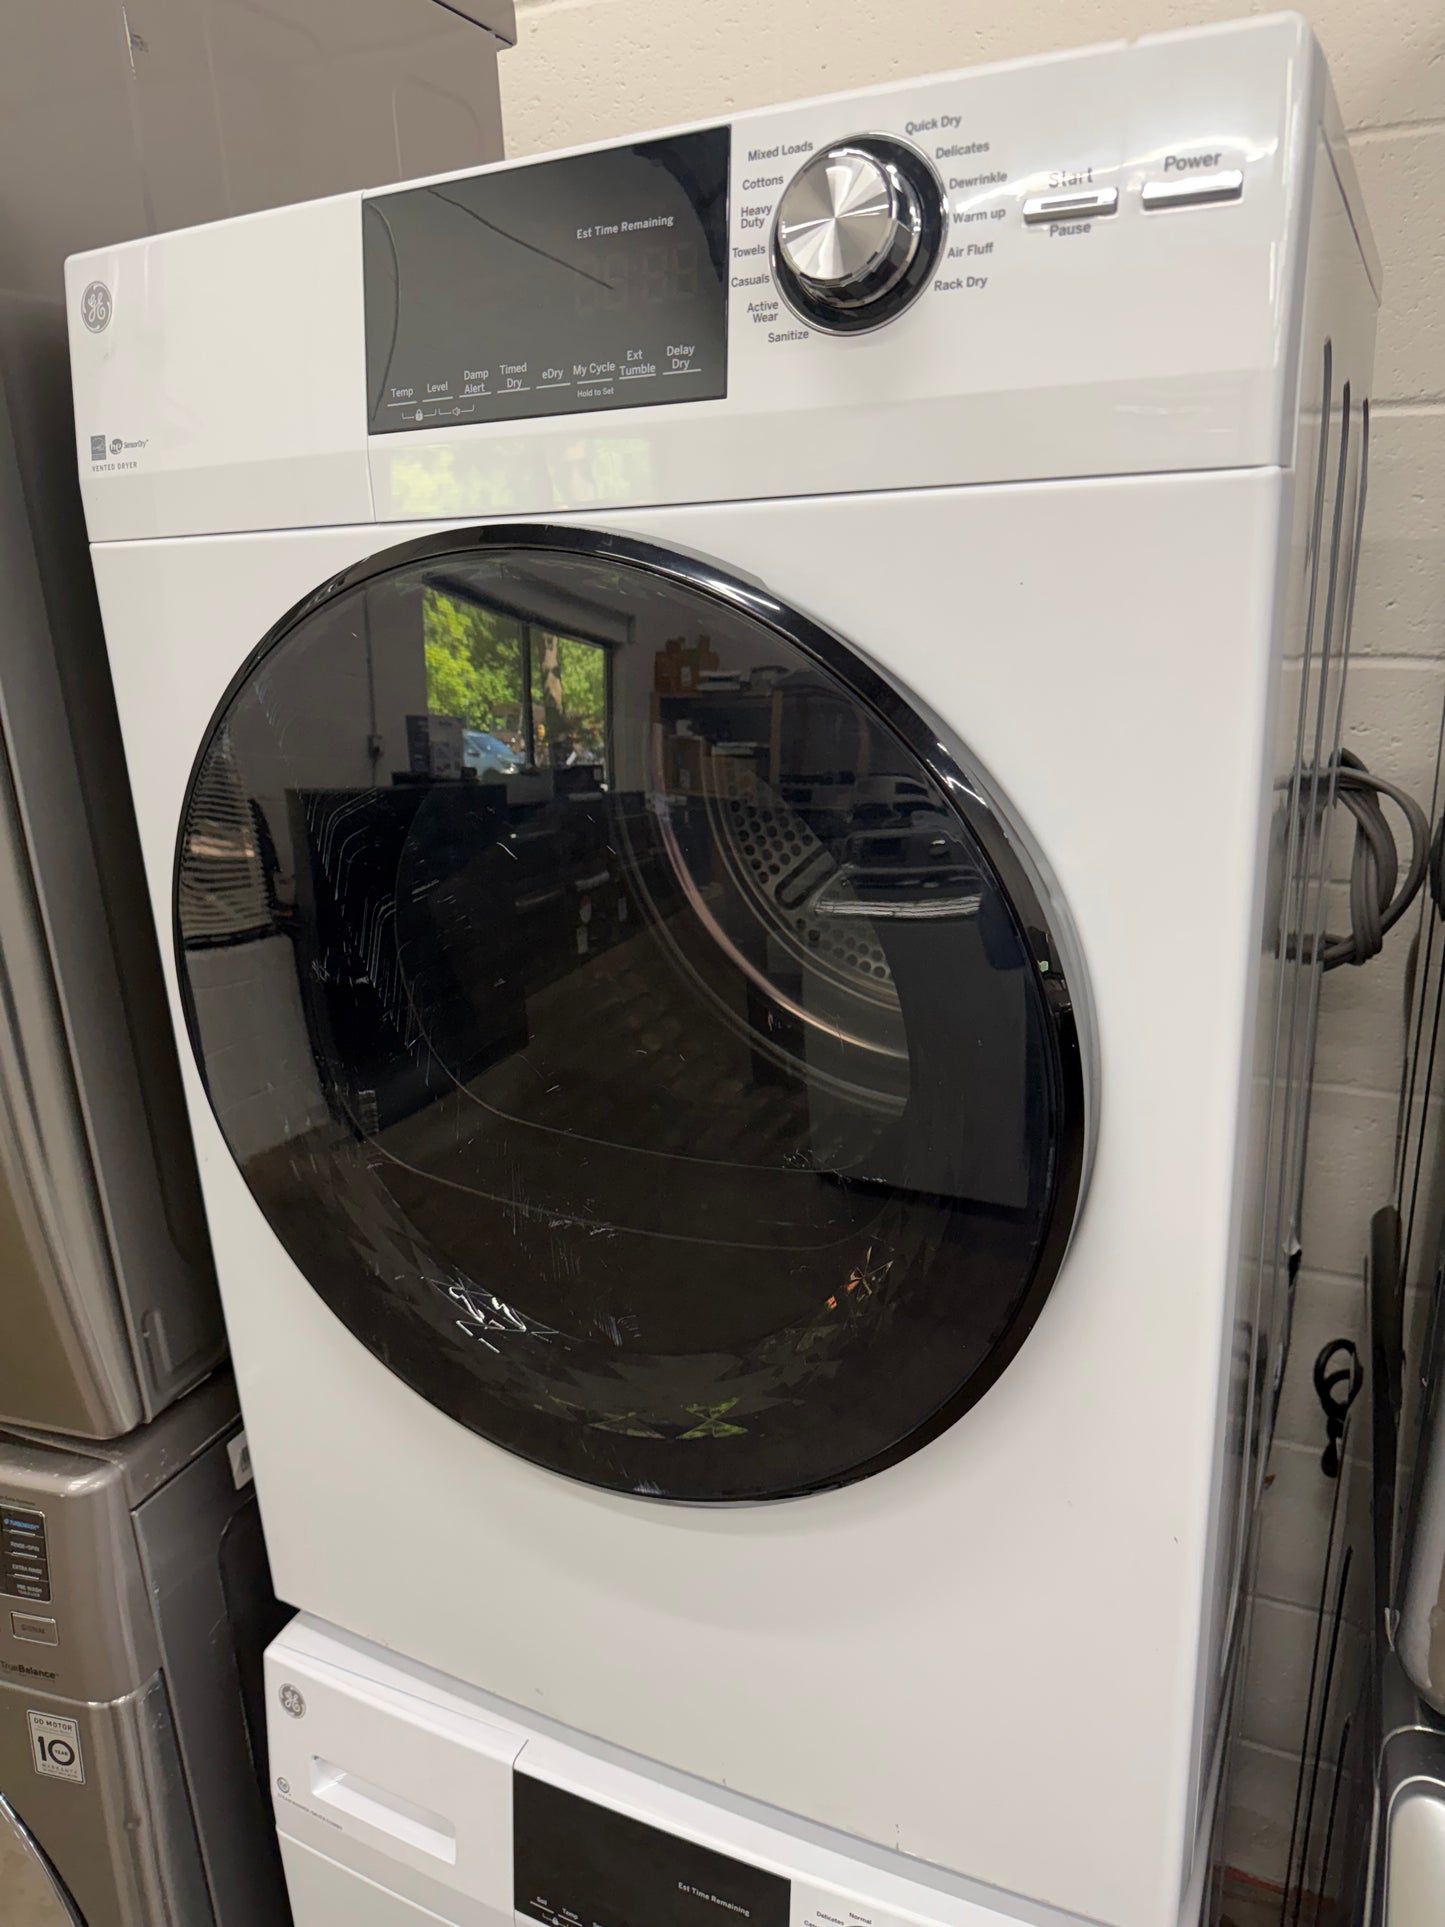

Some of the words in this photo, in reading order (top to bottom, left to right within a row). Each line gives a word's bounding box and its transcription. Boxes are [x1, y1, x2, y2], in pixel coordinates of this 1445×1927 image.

[905, 118, 938, 135] Quick
[940, 115, 962, 130] Dry
[748, 146, 779, 162] Mixed
[781, 141, 814, 157] Loads
[936, 141, 990, 159] Delicates
[1163, 152, 1222, 172] Power
[742, 175, 784, 190] Cottons
[949, 172, 1008, 189] Dewrinkle
[1048, 168, 1093, 188] Start
[741, 204, 772, 218] Heavy
[953, 211, 988, 224] Warm
[990, 208, 1006, 222] up
[576, 228, 593, 240] Est
[595, 224, 619, 237] Time
[621, 214, 674, 233] Remaining
[741, 216, 765, 229] Duty
[1049, 222, 1092, 237] Pause
[732, 244, 766, 258] Towels
[947, 246, 965, 259] Air
[967, 242, 994, 256] Fluff
[731, 274, 770, 288] Casuals
[934, 278, 963, 292] Rack
[965, 276, 988, 291] Dry
[747, 300, 778, 313] Active
[752, 311, 778, 323] Wear
[768, 329, 809, 343] Sanitize
[627, 349, 643, 362] Ext
[666, 344, 695, 359] Delay
[500, 362, 527, 375] Timed
[573, 363, 588, 377] My
[589, 361, 616, 376] Cycle
[619, 362, 656, 376] Tumble
[672, 358, 690, 371] Dry
[464, 368, 489, 382] Damp
[542, 367, 564, 382] eDry
[427, 381, 449, 393] Level
[464, 382, 485, 394] Alert
[506, 377, 522, 390] Dry
[391, 386, 414, 399] Temp
[577, 388, 592, 399] Hold
[593, 388, 601, 397] to
[602, 386, 615, 397] Set
[91, 463, 116, 473] VENTED
[117, 461, 138, 470] DRYER
[46, 1720, 73, 1731] MOTOR
[37, 1735, 75, 1767] 10
[678, 1881, 690, 1893] Est
[691, 1886, 710, 1901] Time
[710, 1894, 751, 1918] Remaining
[561, 1907, 579, 1921] Temp
[816, 1910, 845, 1926] Delicates
[849, 1911, 873, 1925] Normal
